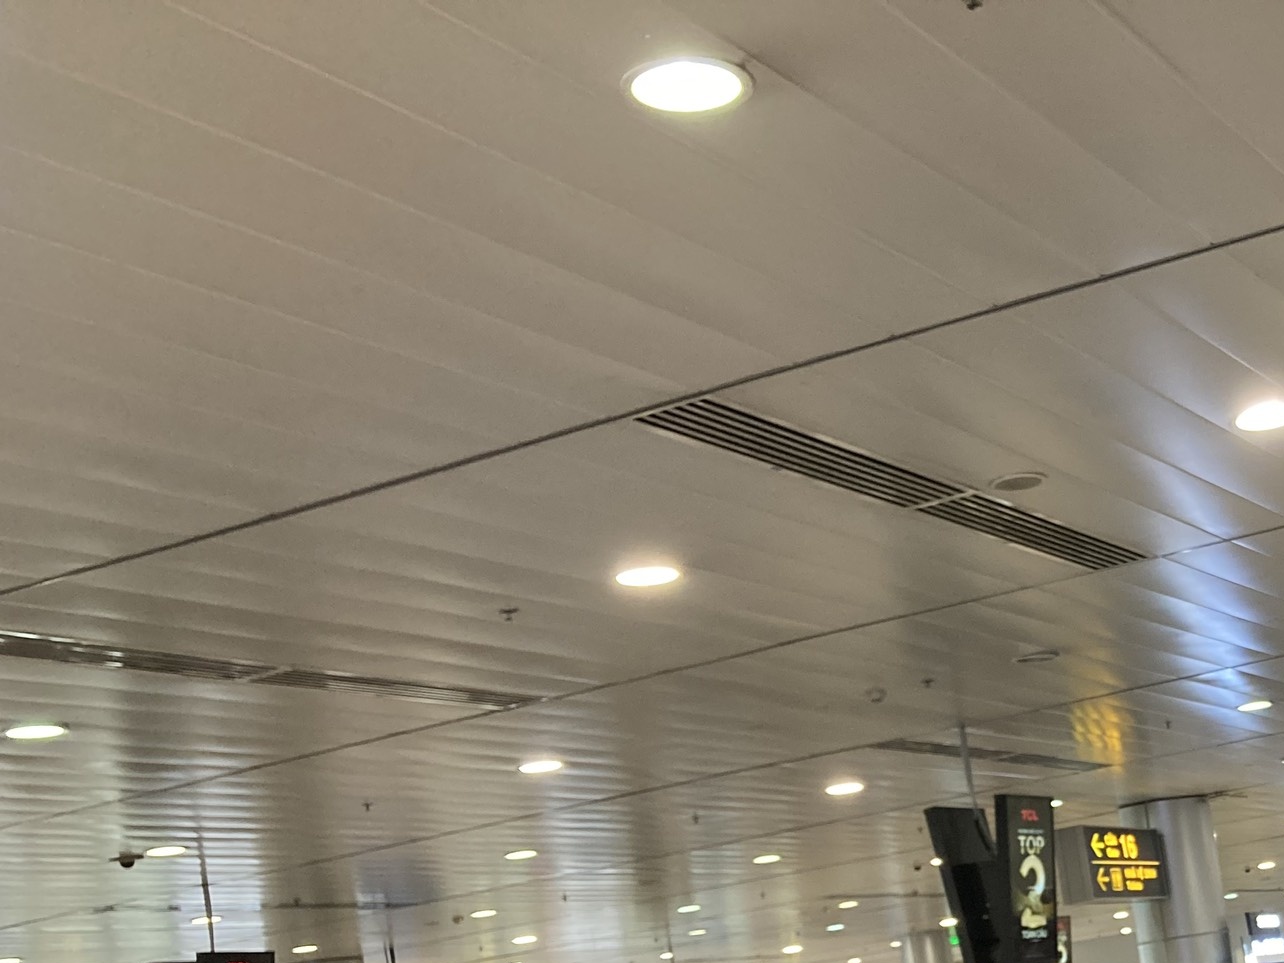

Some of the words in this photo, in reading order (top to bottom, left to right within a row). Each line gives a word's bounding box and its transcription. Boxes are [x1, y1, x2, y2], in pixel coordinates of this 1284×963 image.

[1018, 835, 1045, 855] TOP
[1119, 834, 1138, 859] 16
[1019, 854, 1047, 928] 2
